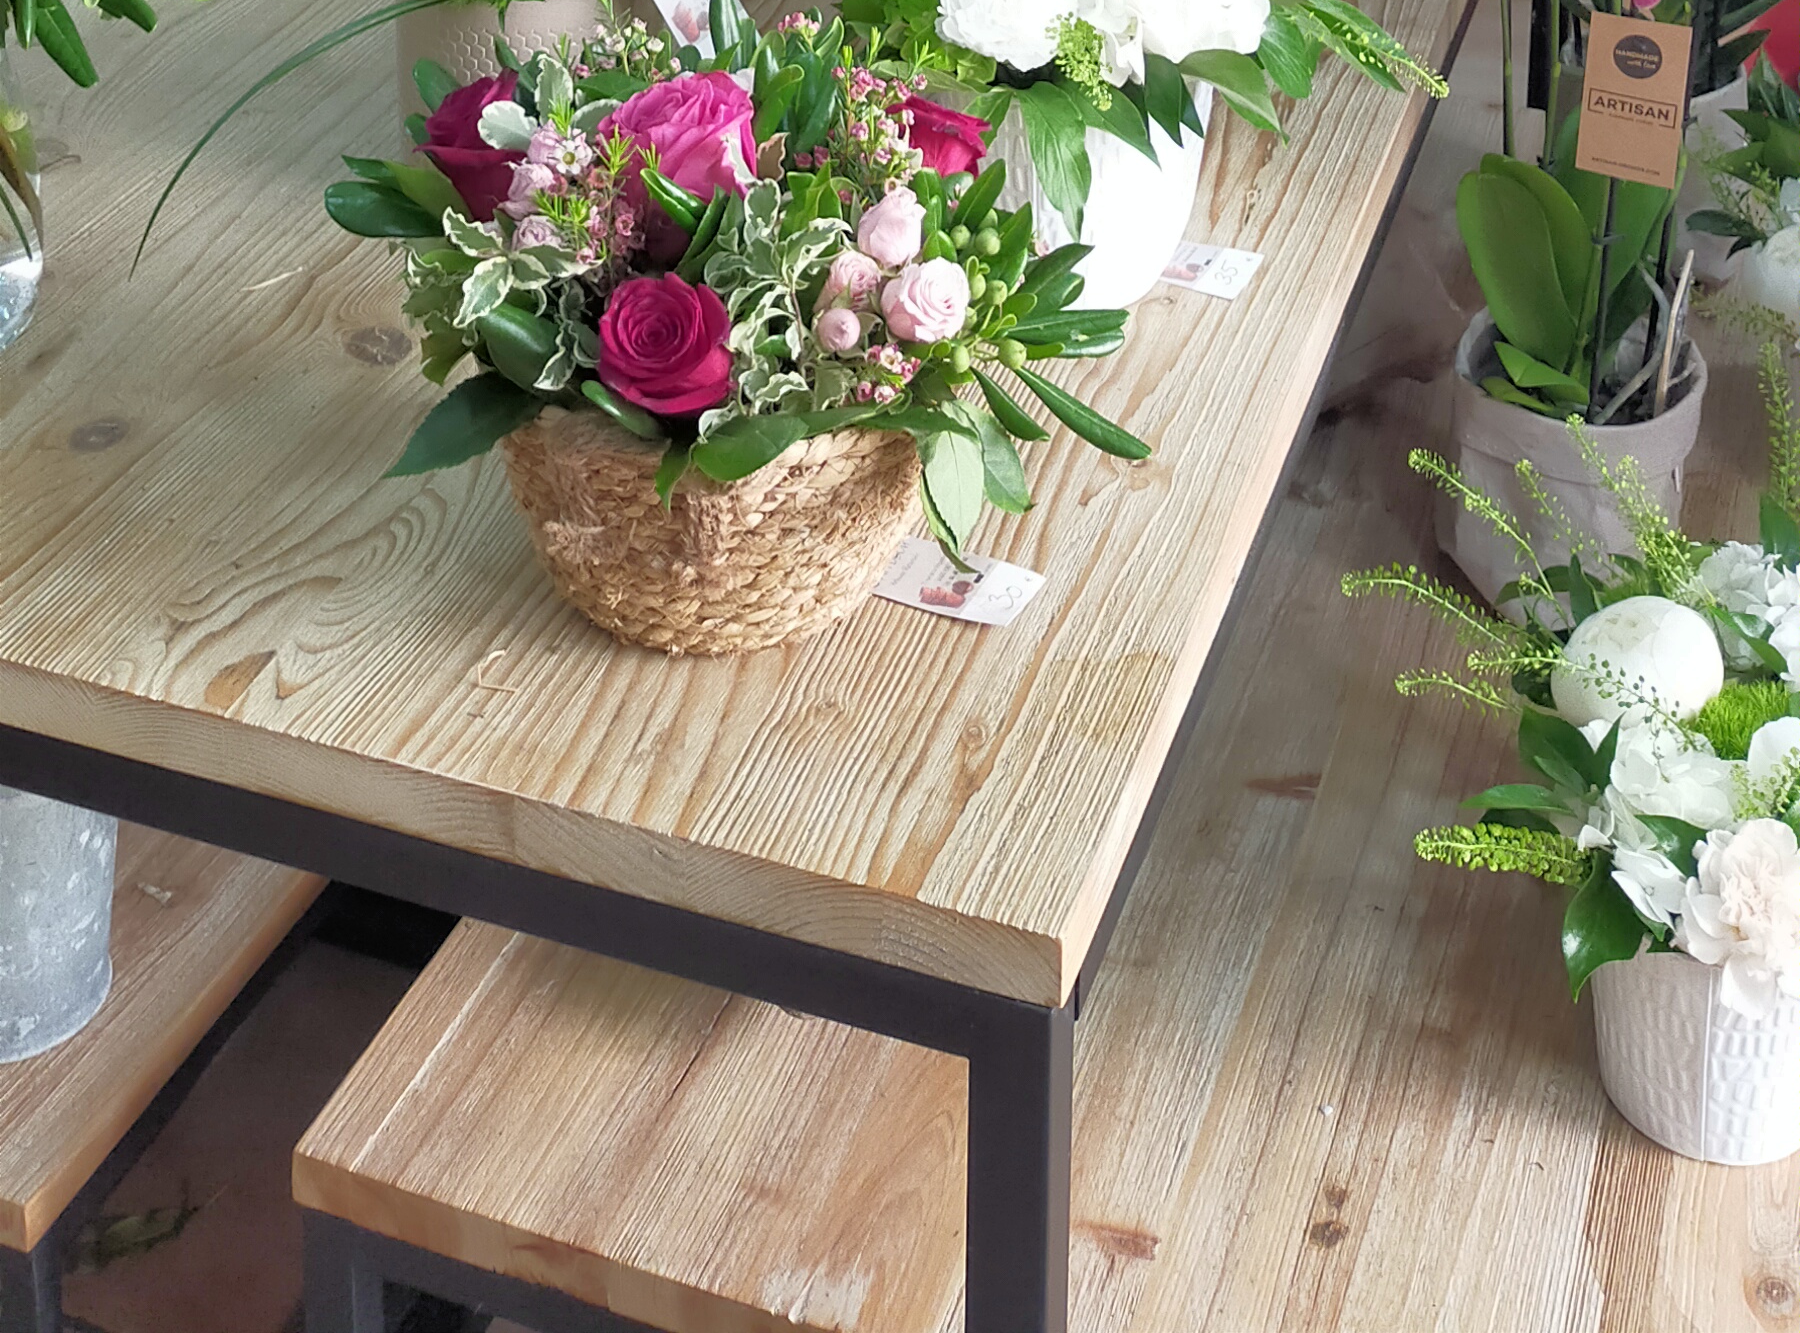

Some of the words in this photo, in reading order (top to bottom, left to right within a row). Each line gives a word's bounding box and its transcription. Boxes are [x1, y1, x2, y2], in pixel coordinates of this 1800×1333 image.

[1616, 49, 1659, 62] HANDMADE
[1593, 95, 1670, 121] ARTISAN
[1214, 259, 1238, 285] 35
[988, 585, 1023, 610] 30
